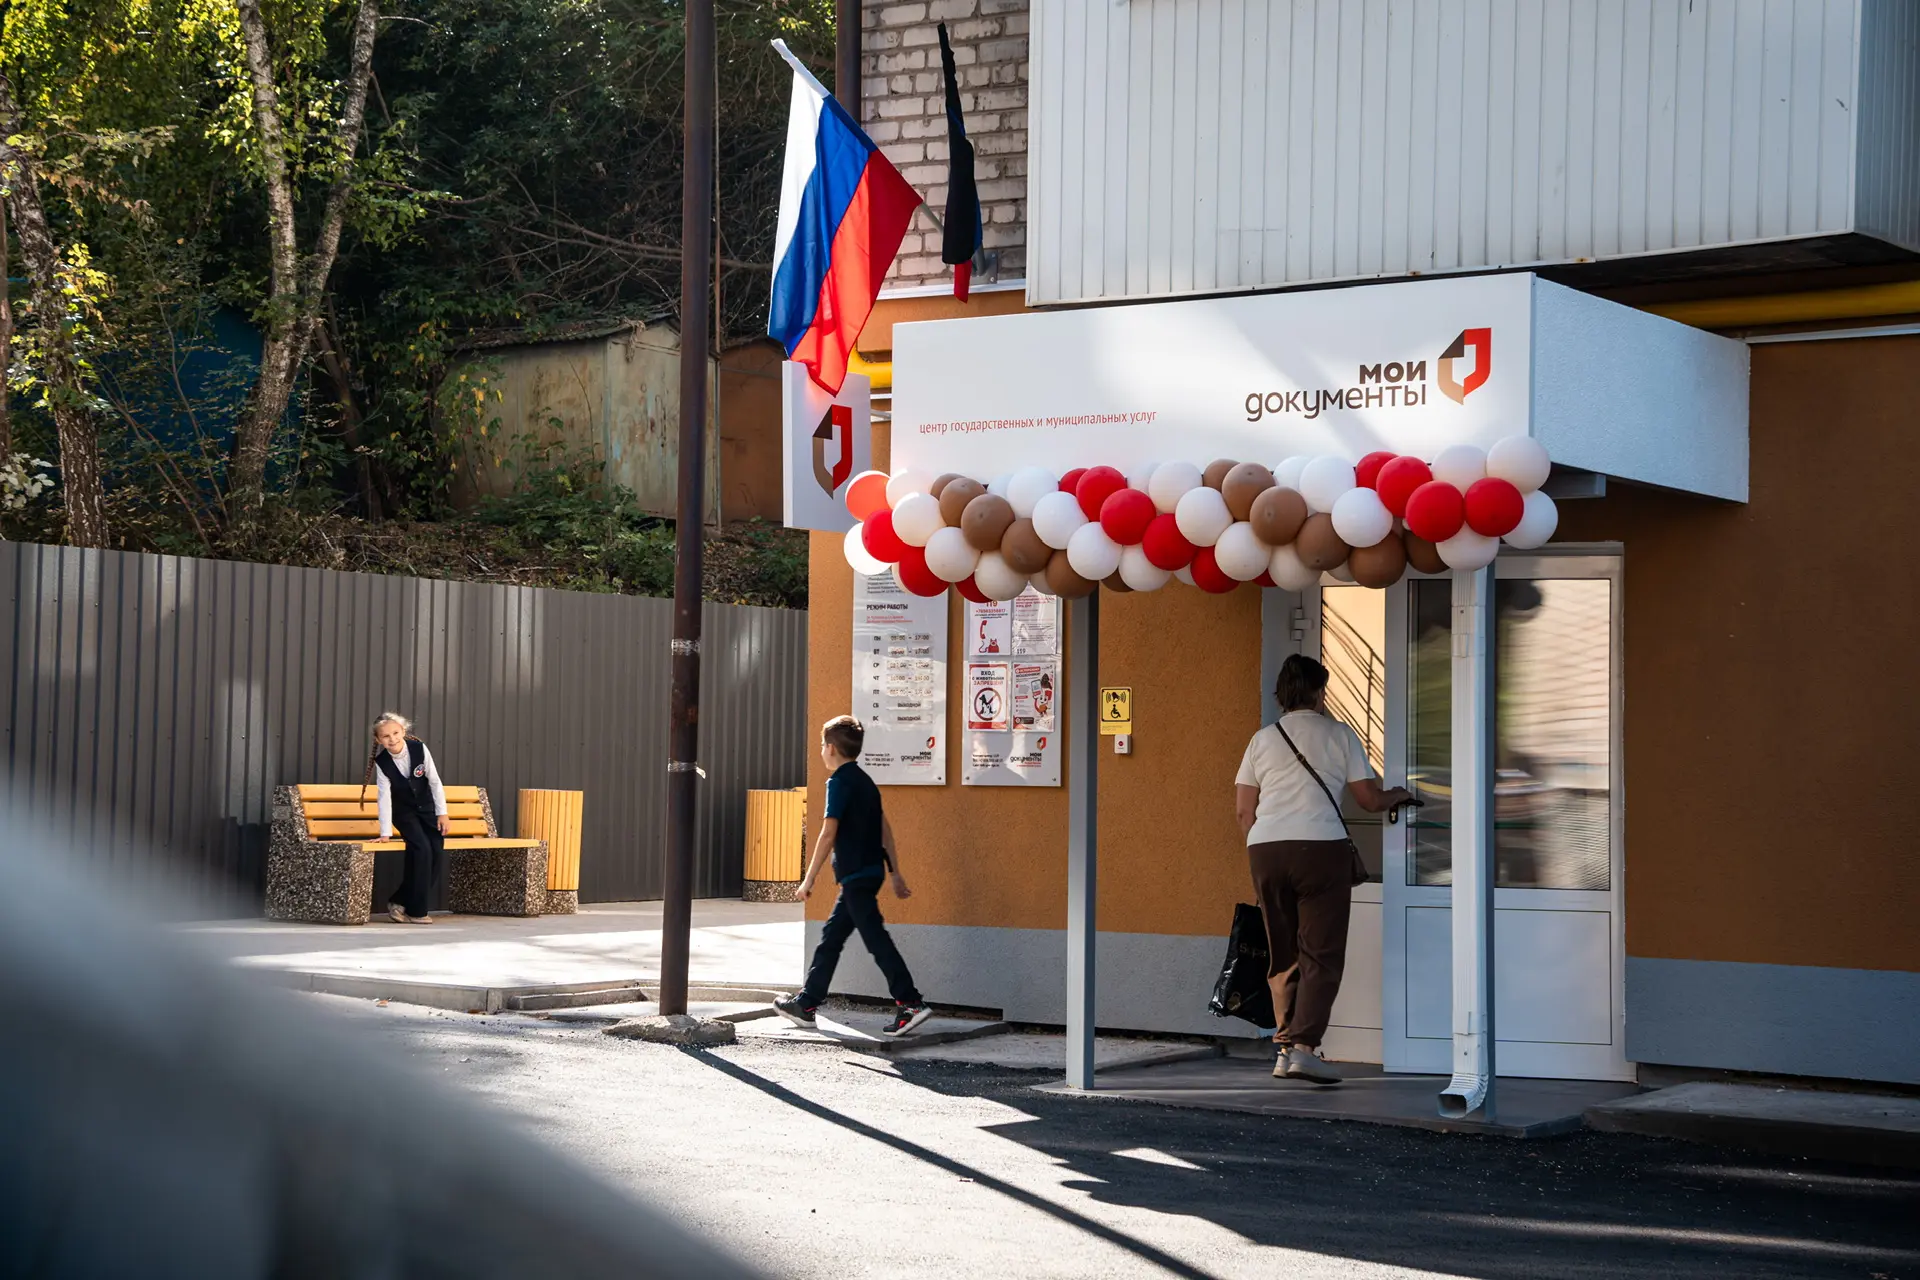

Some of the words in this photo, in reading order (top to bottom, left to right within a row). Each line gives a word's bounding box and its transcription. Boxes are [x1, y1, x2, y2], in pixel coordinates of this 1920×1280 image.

[1245, 384, 1427, 423] документы
[919, 422, 948, 435] центр
[950, 418, 1034, 433] государственных
[1036, 417, 1043, 427] и
[1046, 413, 1127, 430] муниципальных
[1129, 410, 1157, 425] услуг
